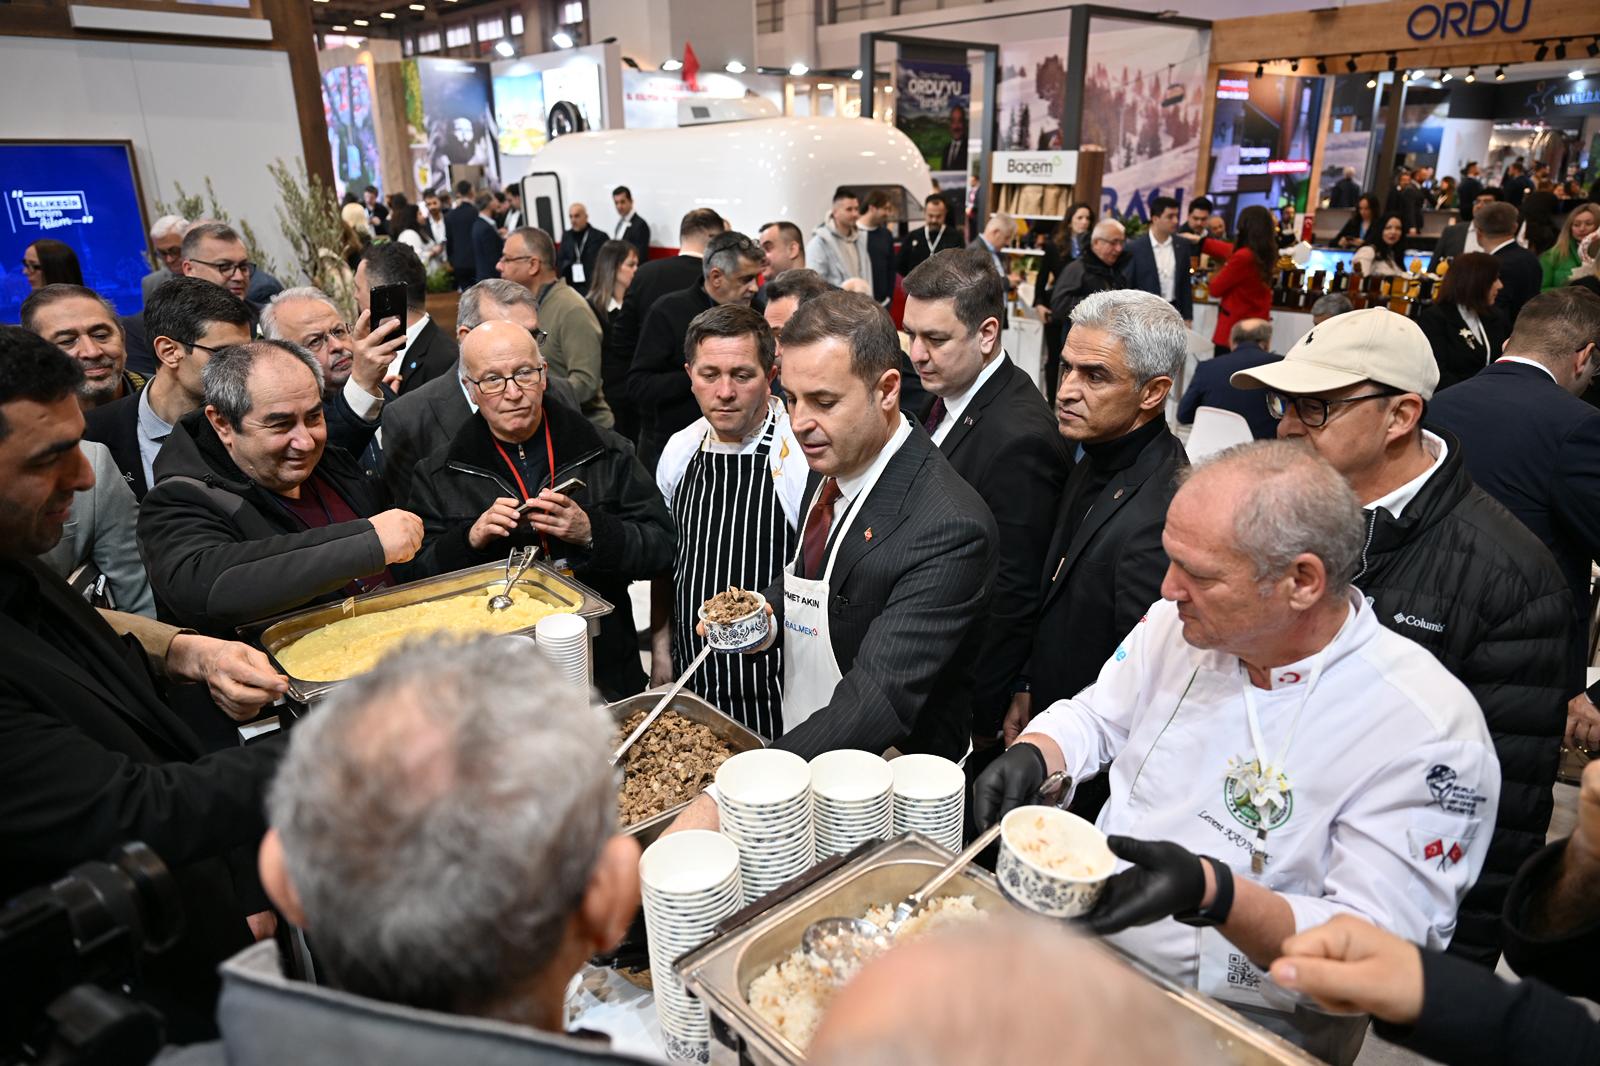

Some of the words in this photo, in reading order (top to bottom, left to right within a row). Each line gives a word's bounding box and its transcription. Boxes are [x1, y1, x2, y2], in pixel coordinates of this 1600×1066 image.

[1407, 0, 1532, 40] ORDU
[1007, 159, 1053, 174] Baçem
[801, 597, 820, 608] AKIN
[1198, 810, 1224, 831] Levent
